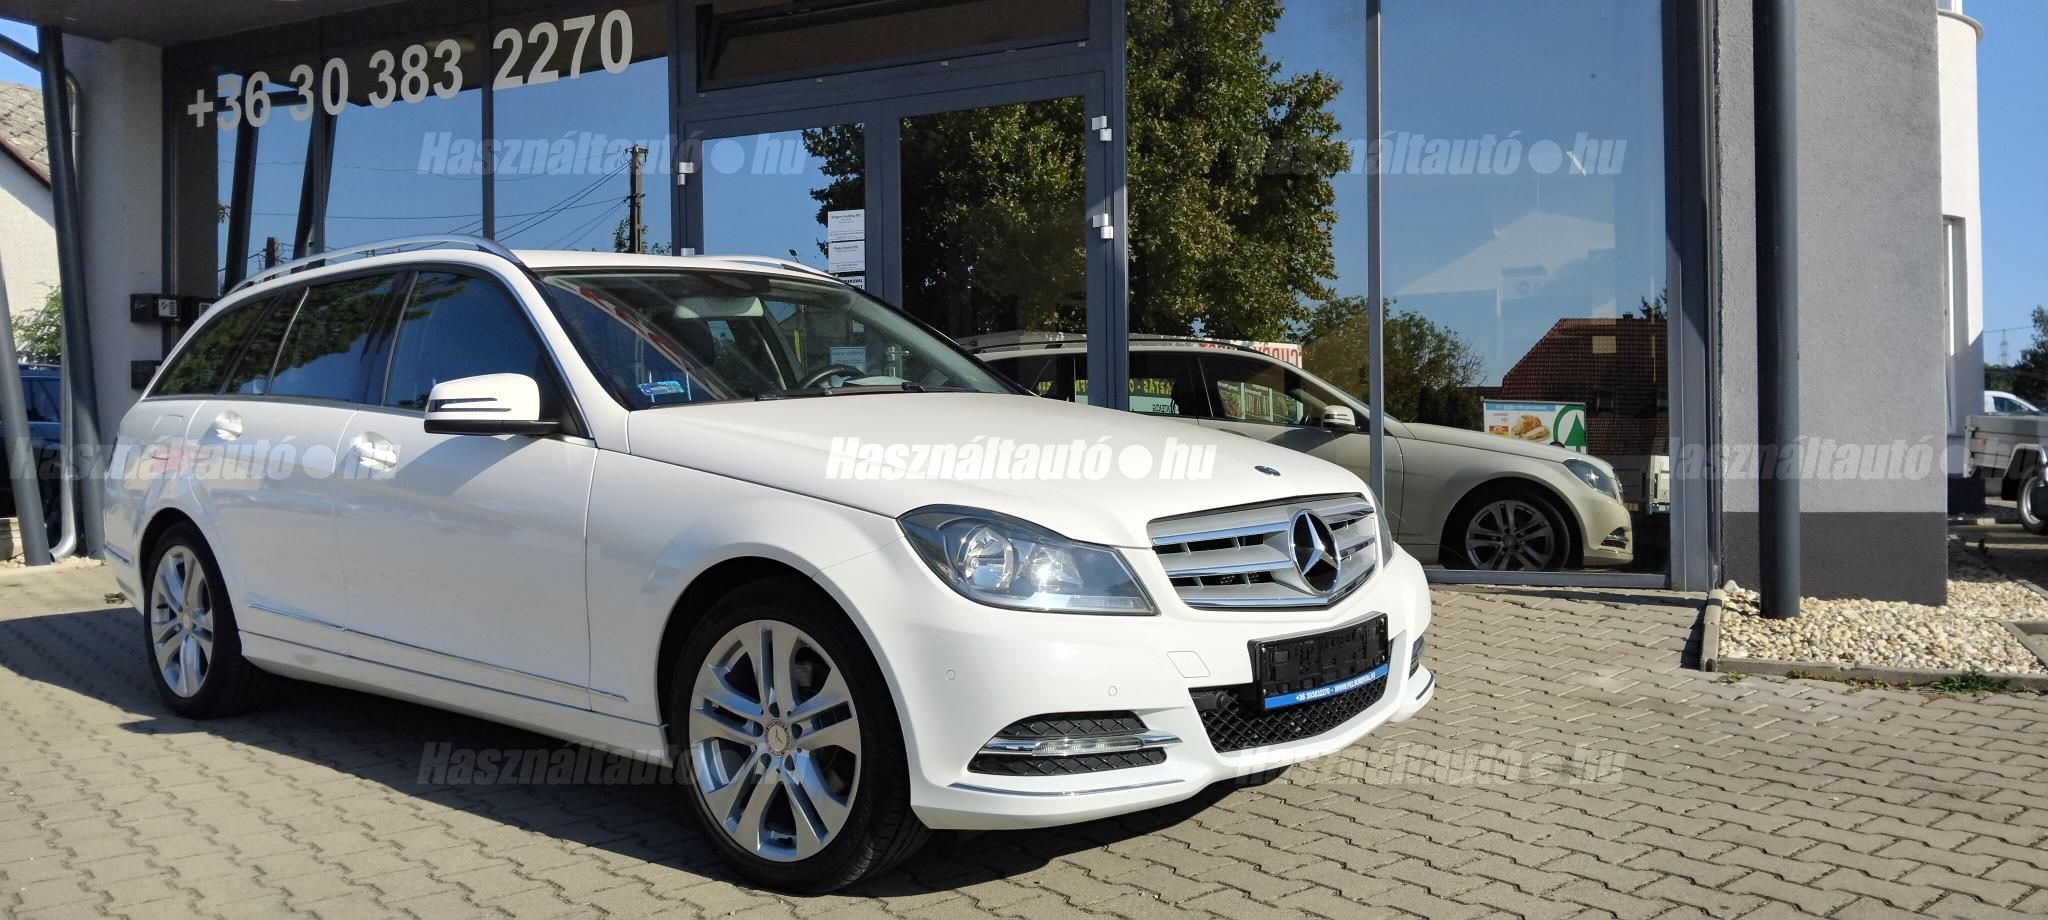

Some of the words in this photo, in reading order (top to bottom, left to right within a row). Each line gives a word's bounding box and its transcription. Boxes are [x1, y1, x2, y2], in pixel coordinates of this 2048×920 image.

[187, 71, 271, 131] +36
[289, 58, 348, 121] 30
[368, 38, 463, 109] 383
[492, 9, 633, 91] 2270
